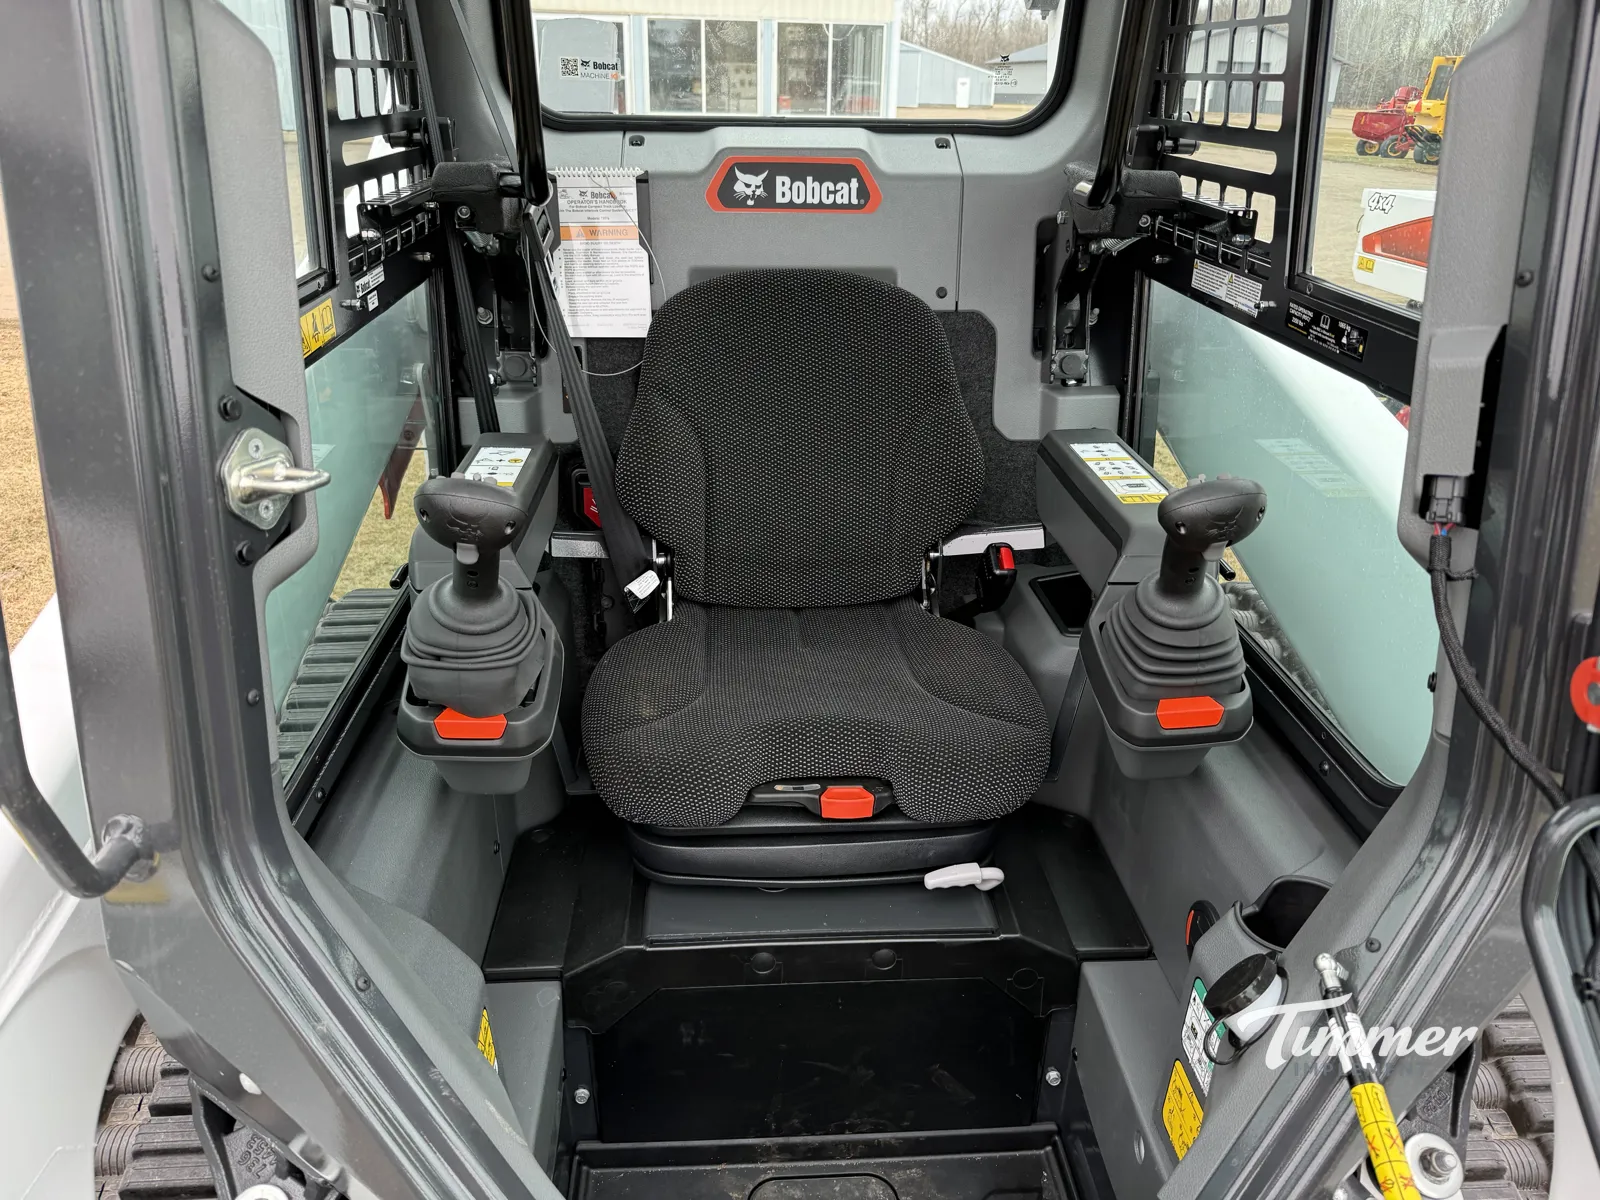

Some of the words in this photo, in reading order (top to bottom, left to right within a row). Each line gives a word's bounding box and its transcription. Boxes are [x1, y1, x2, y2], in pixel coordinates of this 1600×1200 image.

[593, 61, 618, 70] Bobcat
[775, 175, 859, 205] Bobcat
[1368, 191, 1396, 215] 4x4
[589, 229, 628, 237] WARNING
